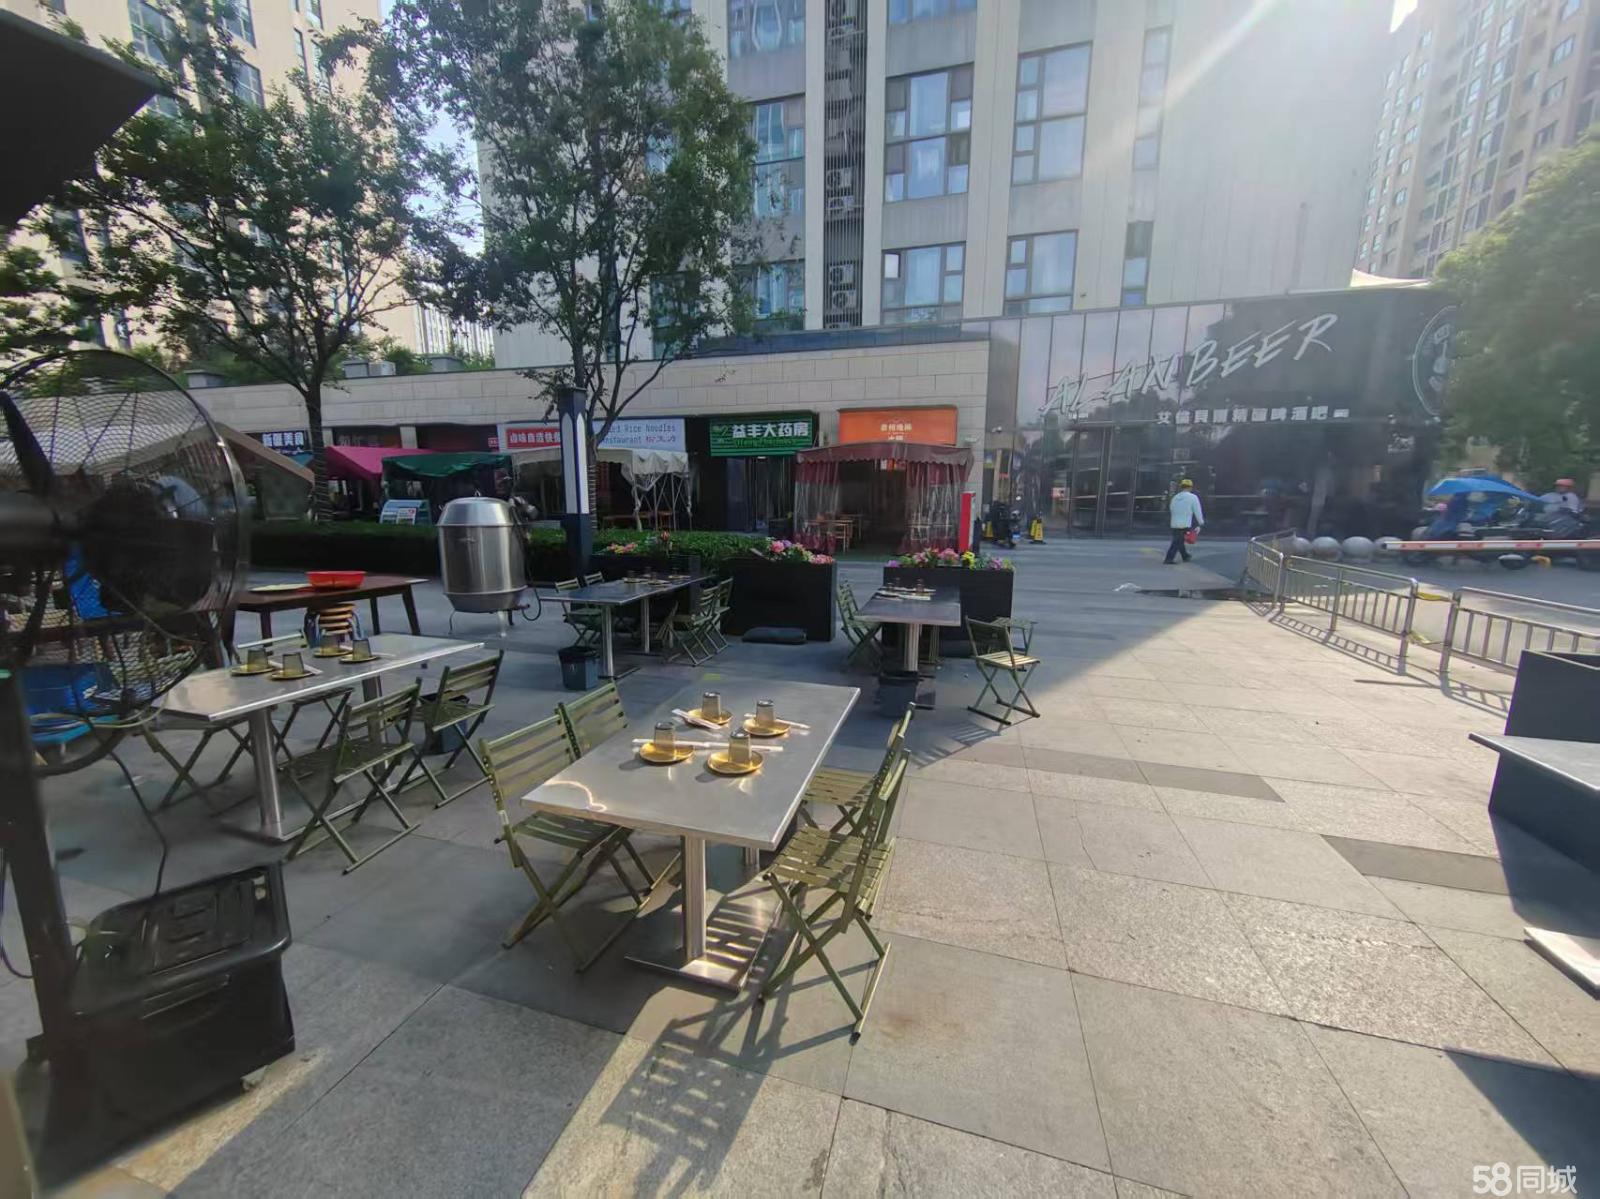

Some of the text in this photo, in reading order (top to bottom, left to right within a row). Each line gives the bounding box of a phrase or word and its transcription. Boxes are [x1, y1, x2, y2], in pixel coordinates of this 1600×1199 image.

[1186, 312, 1338, 387] BEER
[646, 423, 676, 434] Noodles
[732, 421, 809, 438] 益丰大药房
